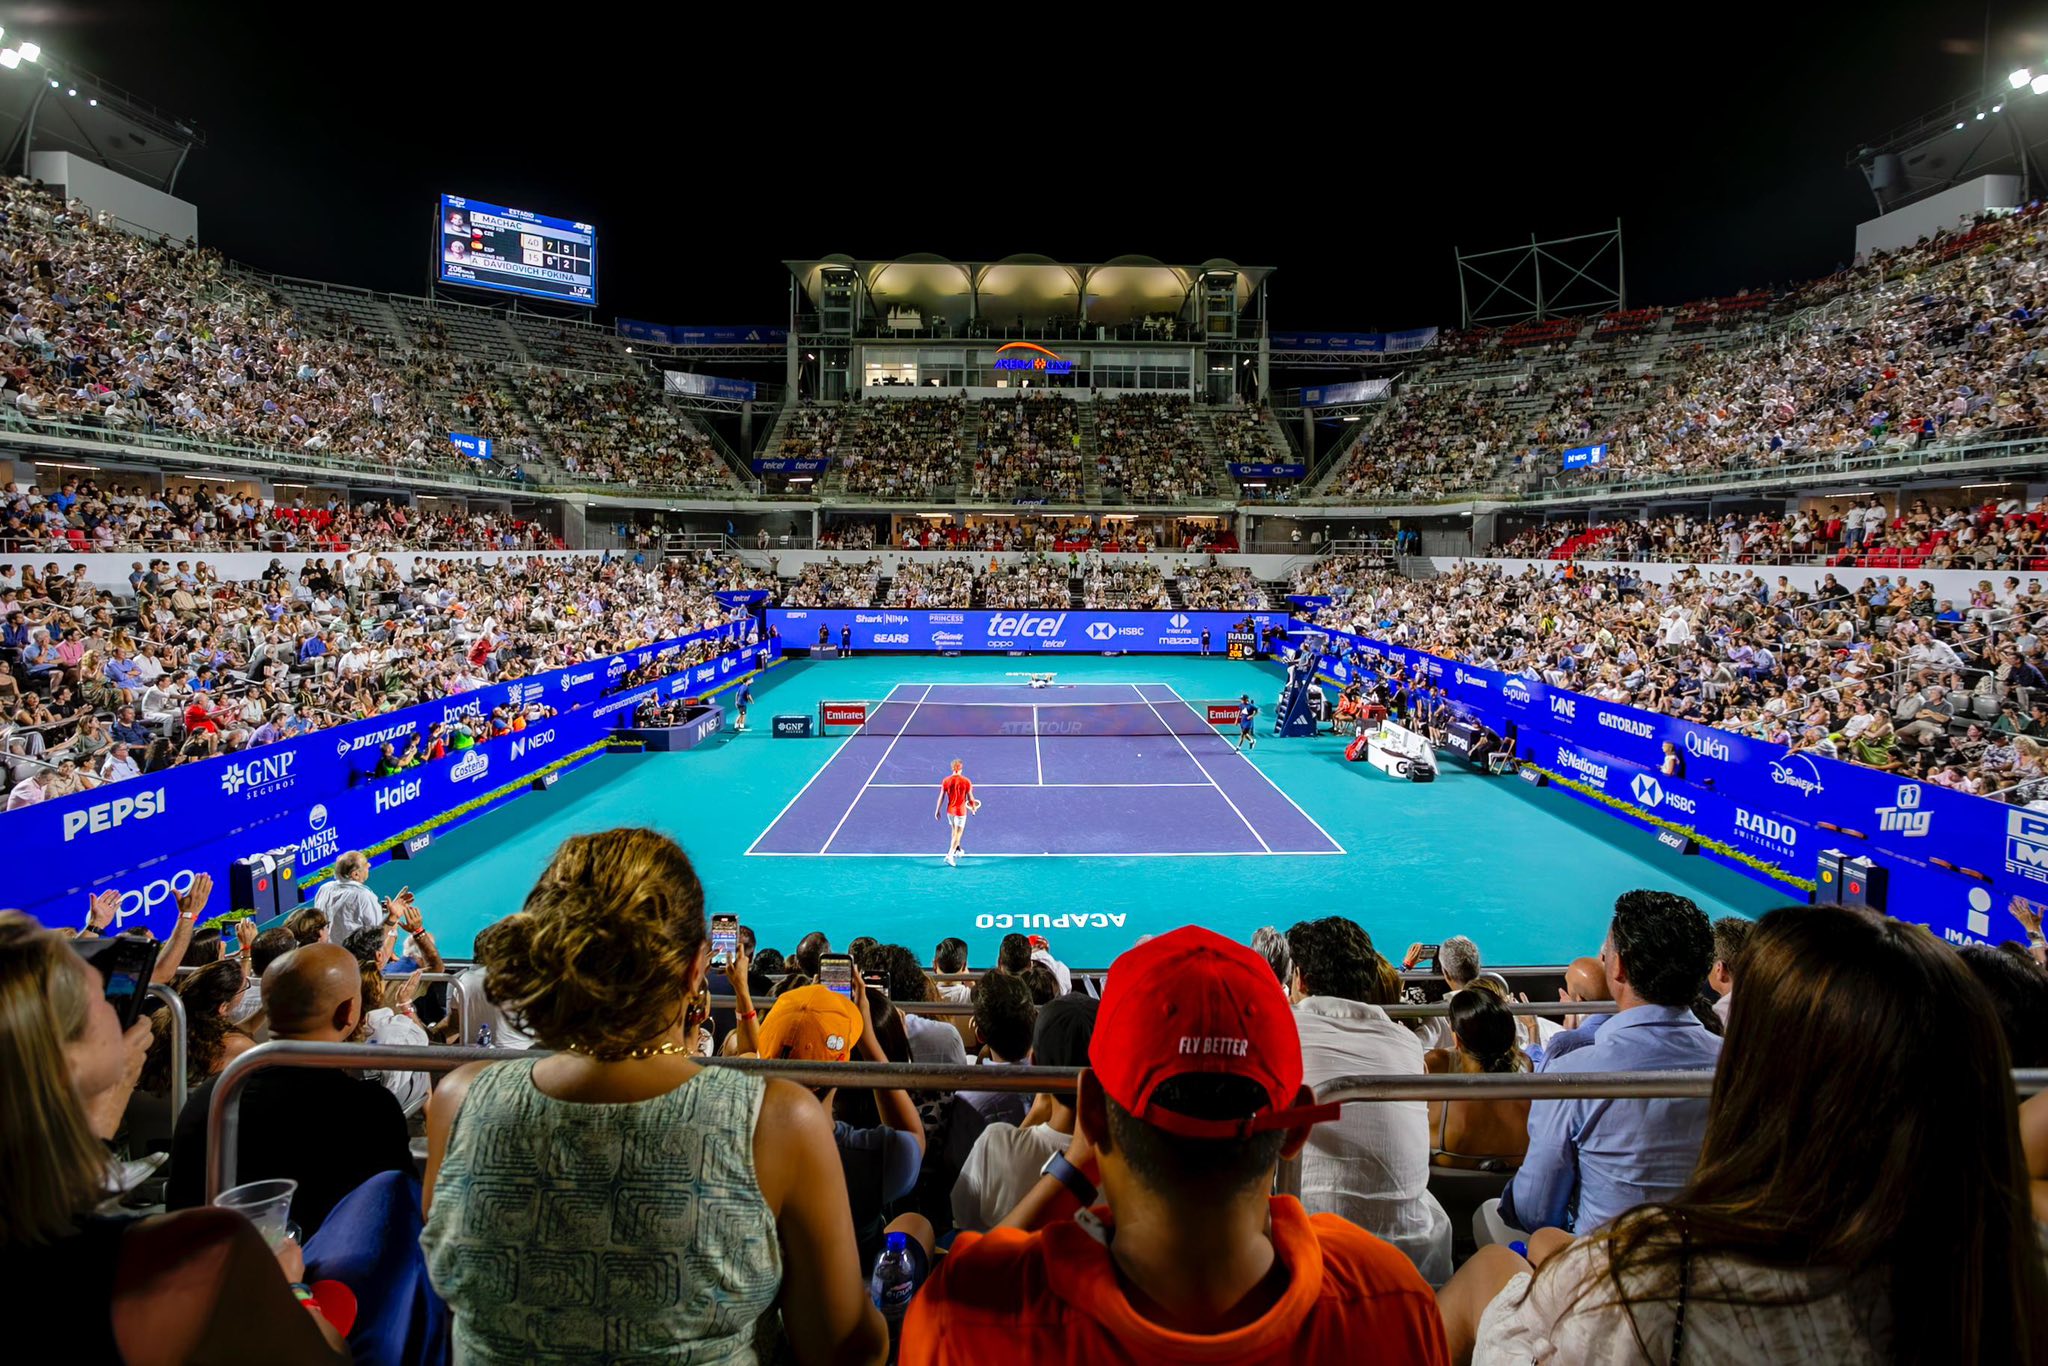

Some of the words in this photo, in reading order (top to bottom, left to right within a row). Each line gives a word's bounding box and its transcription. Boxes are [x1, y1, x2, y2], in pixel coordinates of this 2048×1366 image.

[482, 215, 522, 230] MACHAC
[527, 238, 540, 248] 40
[546, 241, 553, 250] 7
[563, 245, 570, 254] 5
[483, 259, 540, 275] DAVIDOVICH
[541, 269, 575, 282] FOKINA
[528, 253, 540, 262] 15
[546, 256, 553, 265] 6
[563, 260, 570, 269] 2
[763, 461, 785, 470] telcel
[795, 461, 818, 470] telcel
[855, 614, 883, 623] Shark
[987, 612, 1067, 637] telcel
[873, 633, 909, 643] SEARS
[1118, 627, 1145, 636] HSBC
[1158, 637, 1199, 645] mazda
[1227, 632, 1255, 640] RADO
[987, 640, 1014, 648] oppo
[1042, 639, 1067, 648] telcel
[826, 710, 864, 720] Emirates
[1550, 695, 1576, 719] TANE
[785, 722, 804, 730] GNP
[1038, 722, 1082, 734] TOUR
[1598, 711, 1653, 739] GATORADE
[352, 721, 417, 751] DUNLOP
[528, 728, 556, 751] NEXO
[1447, 733, 1468, 752] PEPSI
[1684, 731, 1730, 762] Quién
[246, 751, 294, 787] GNP
[1568, 753, 1608, 780] National
[247, 778, 295, 800] SEGUROS
[375, 777, 422, 813] Haier
[1666, 791, 1696, 815] HSBC
[63, 787, 166, 842] PEPSI
[1875, 806, 1934, 838] Ting
[1734, 808, 1797, 847] RADO
[300, 826, 339, 853] AMSTEL
[410, 833, 430, 852] telcel
[1658, 832, 1683, 848] telcel
[1733, 828, 1796, 858] SWITZERLAND
[301, 840, 339, 866] ULTRA
[85, 869, 195, 928] ppo
[975, 912, 1127, 929] ACAPULCO
[1178, 1036, 1201, 1055] FLY
[1203, 1036, 1249, 1057] BETTER
